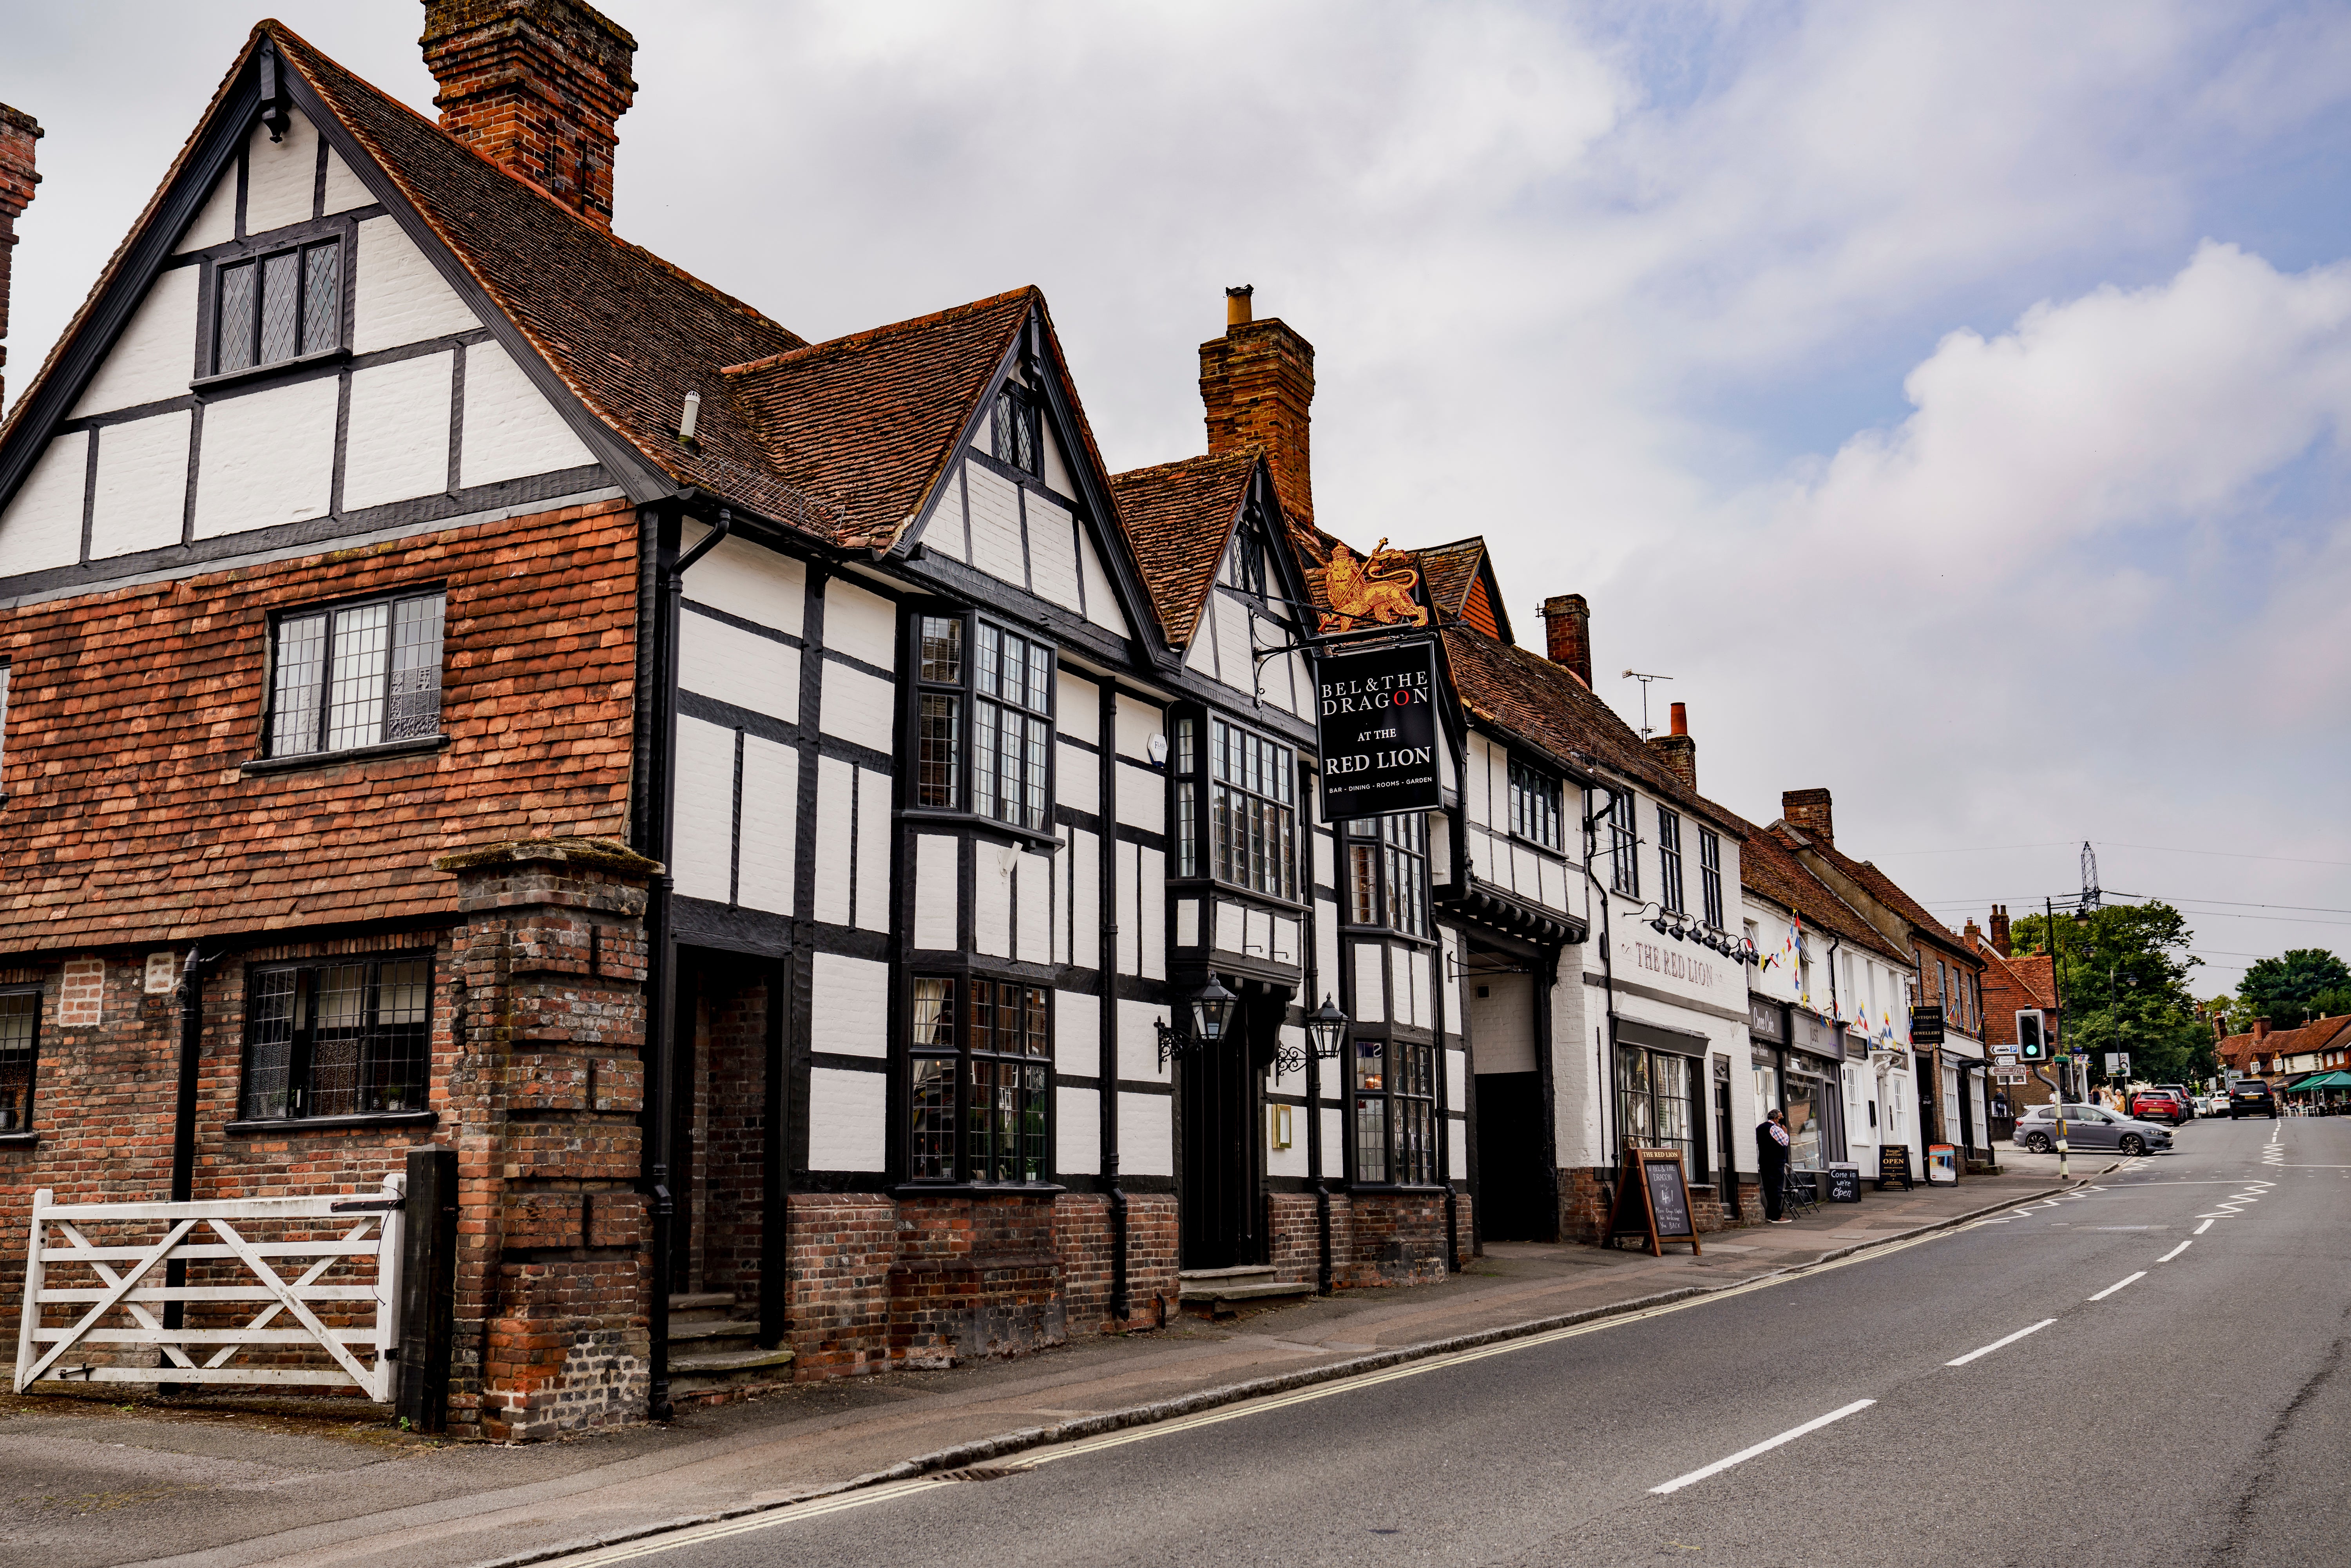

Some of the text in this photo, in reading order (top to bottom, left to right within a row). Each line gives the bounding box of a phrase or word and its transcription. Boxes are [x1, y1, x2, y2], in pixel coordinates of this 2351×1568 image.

[1322, 687, 1428, 715] DRAGON
[1357, 728, 1396, 741] AT THE
[1326, 746, 1431, 775] RED LION
[1636, 941, 1713, 988] THE RED LION
[1753, 1007, 1765, 1030] Cross
[1765, 1010, 1774, 1033] Cuts
[1809, 1022, 1818, 1045] just
[1833, 1186, 1851, 1199] Open
